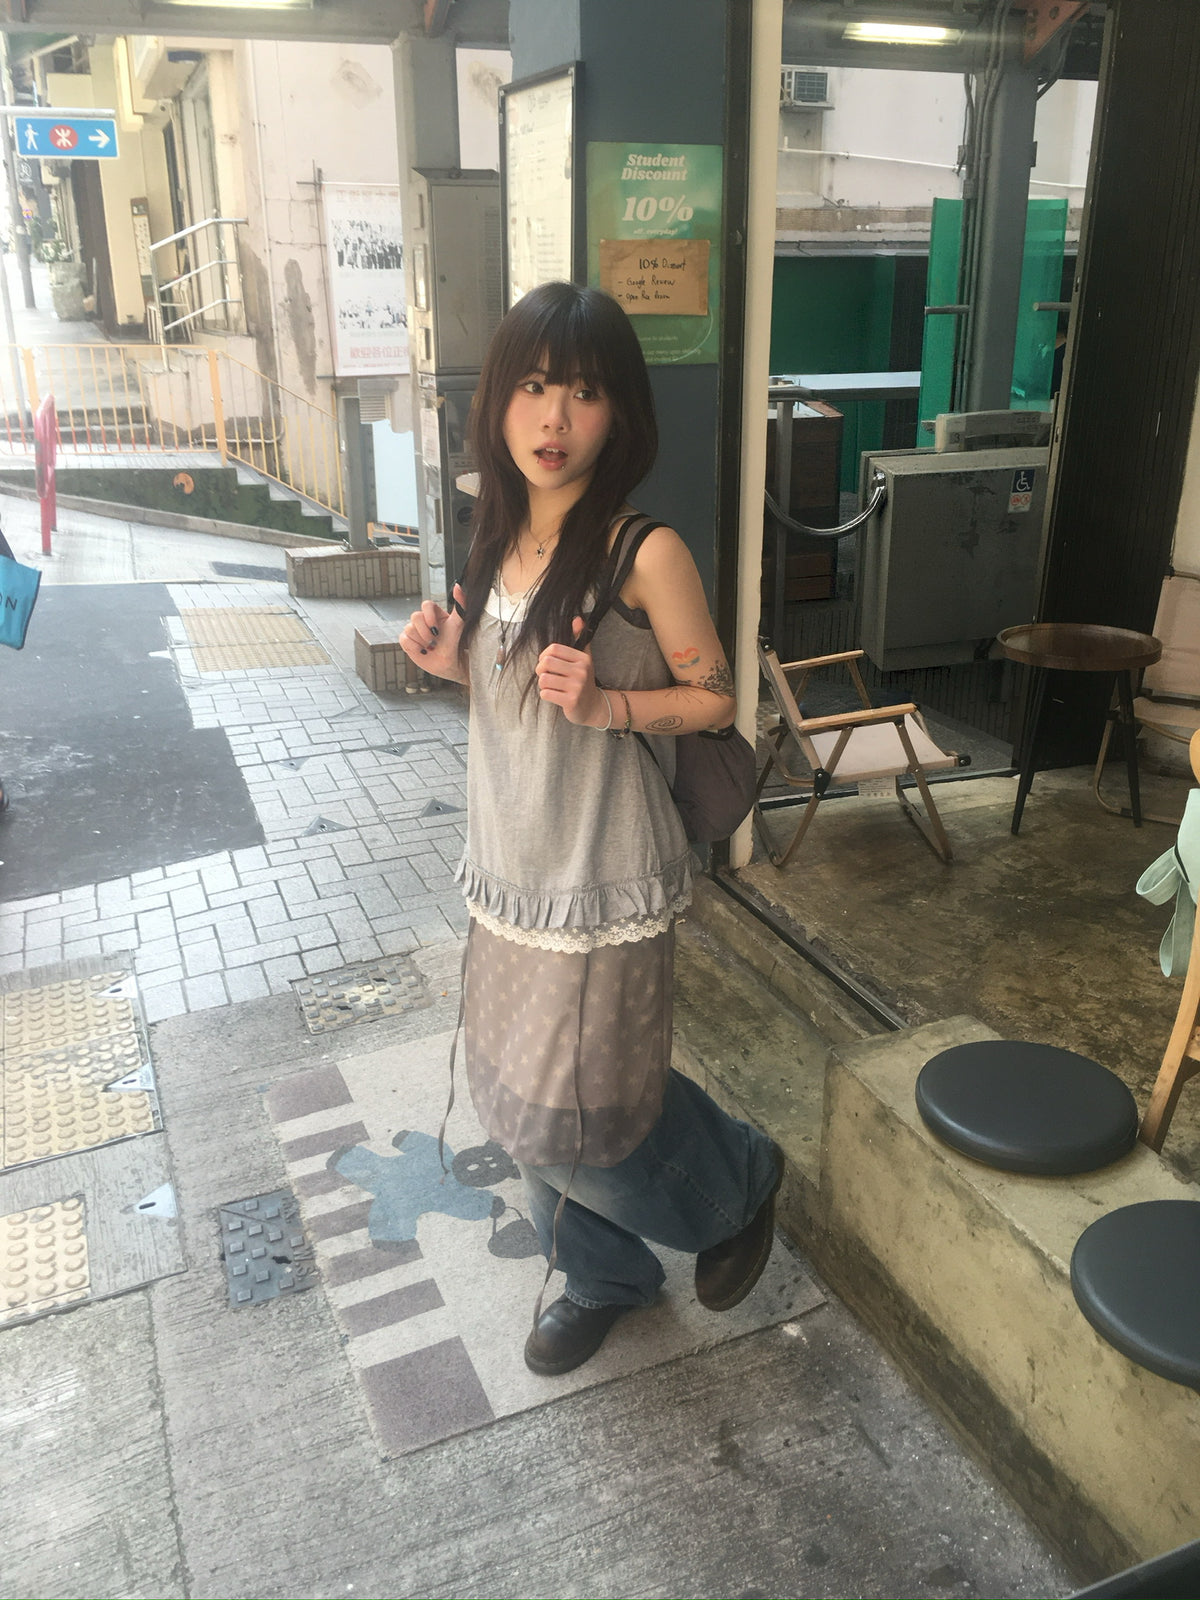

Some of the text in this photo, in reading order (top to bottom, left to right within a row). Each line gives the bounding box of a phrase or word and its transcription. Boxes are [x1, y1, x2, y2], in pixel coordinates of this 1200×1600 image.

[626, 153, 685, 167] Student
[621, 167, 688, 181] Discount
[622, 194, 694, 223] 10%
[640, 258, 659, 270] 10%
[0, 592, 18, 611] N
